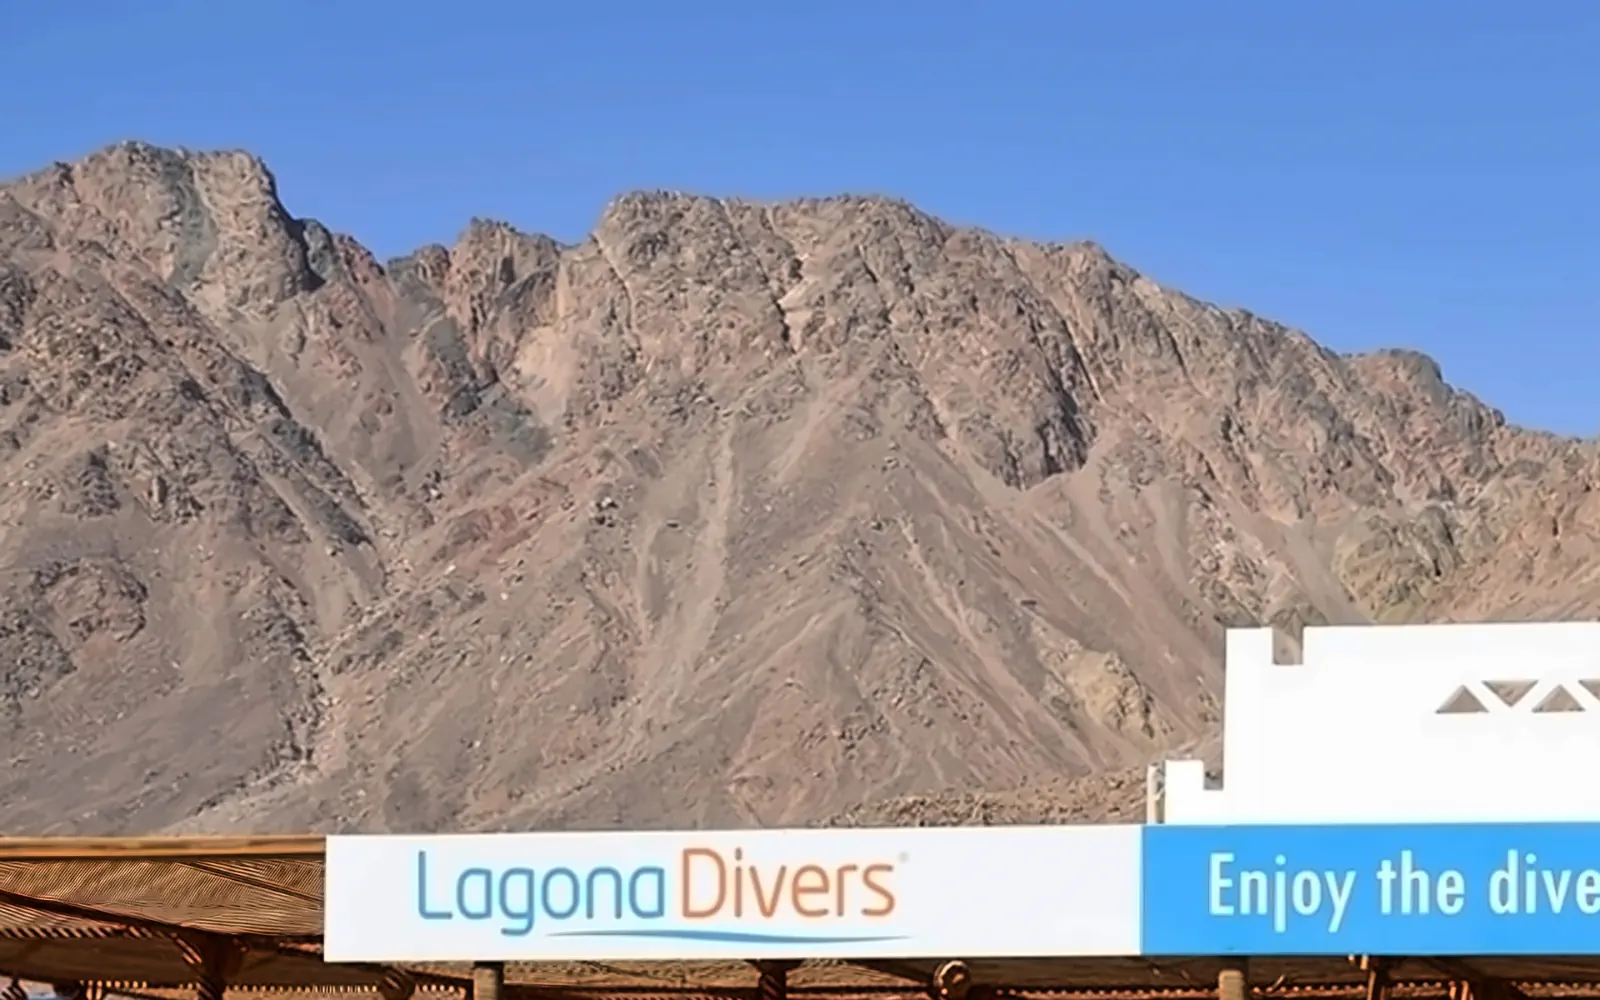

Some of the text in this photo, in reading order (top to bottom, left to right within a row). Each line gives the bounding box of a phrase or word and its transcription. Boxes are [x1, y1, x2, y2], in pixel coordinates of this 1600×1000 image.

[417, 846, 896, 937] Lagona Divers
[1209, 852, 1356, 933] Enjoy
[1376, 850, 1465, 915] the
